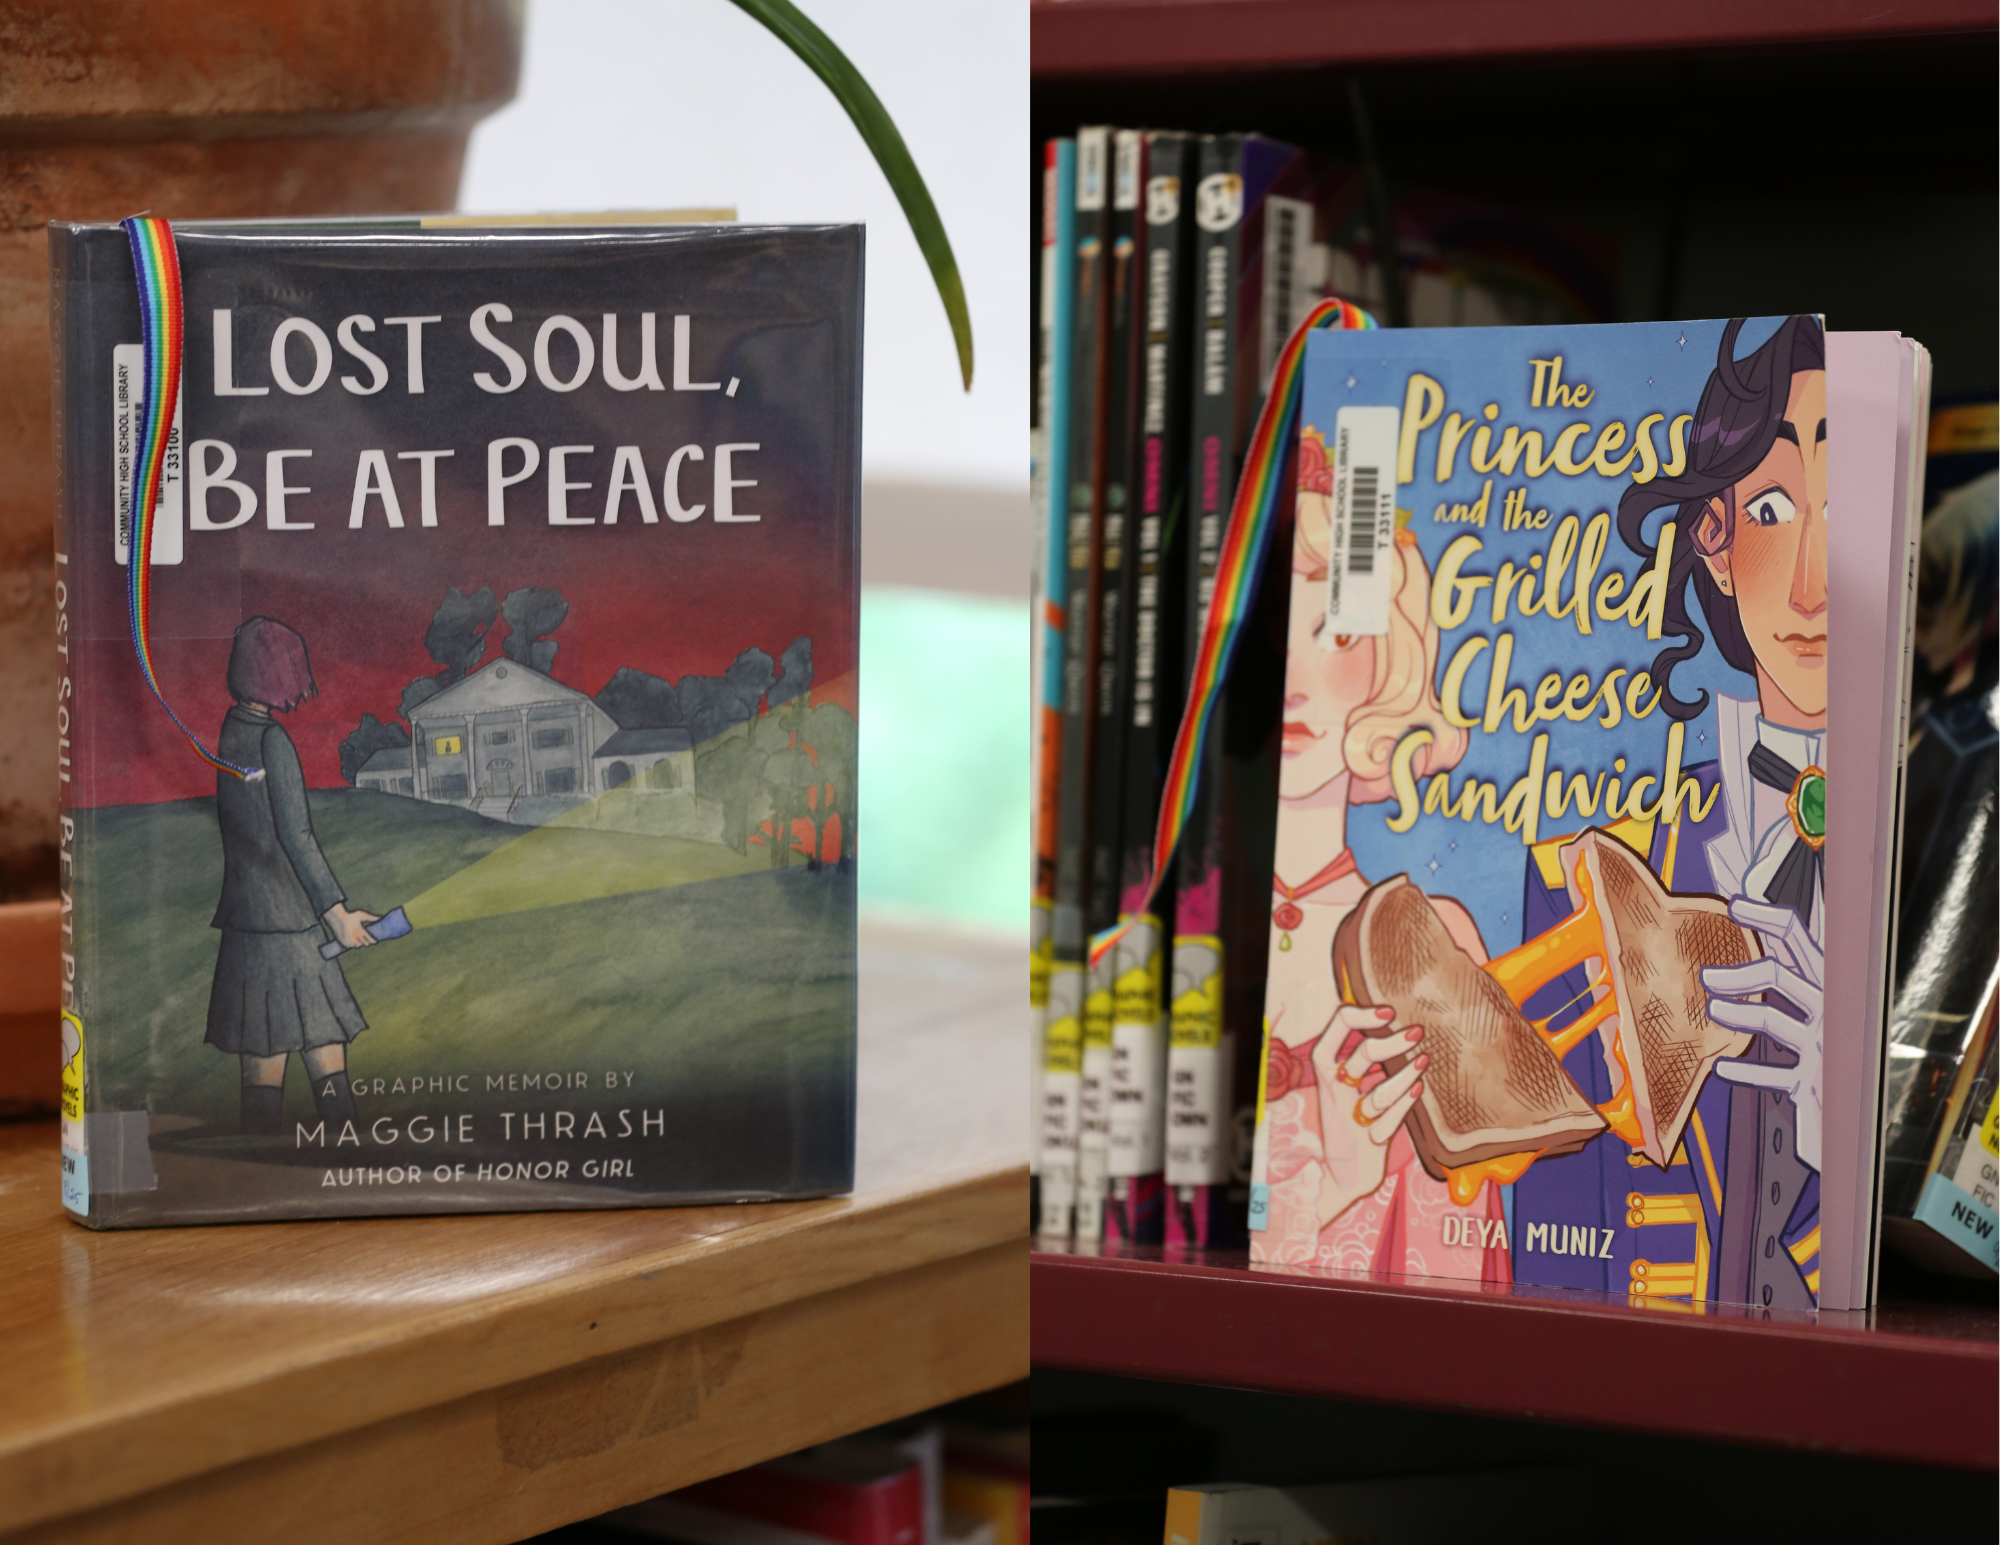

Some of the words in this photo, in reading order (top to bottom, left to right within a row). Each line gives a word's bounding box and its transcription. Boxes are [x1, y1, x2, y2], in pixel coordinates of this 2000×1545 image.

[212, 308, 442, 396] LOST
[469, 302, 741, 398] SOUL,
[118, 363, 129, 409] LIBRARY
[1528, 355, 1595, 408] The
[119, 410, 129, 454] SCHOOL
[1339, 426, 1349, 473] LIBRARY
[1397, 373, 1695, 485] Princess
[119, 456, 129, 479] HIGH
[167, 473, 179, 484] T
[188, 439, 315, 531] BE
[348, 447, 455, 529] AT
[487, 436, 761, 526] PEACE
[119, 479, 130, 547] COMMUNITY
[1336, 476, 1348, 522] SCHOOL
[1379, 493, 1392, 535] 33111
[1433, 478, 1494, 529] and
[1502, 487, 1553, 531] the
[1334, 522, 1344, 550] HIGH
[1378, 540, 1388, 550] T
[1330, 550, 1343, 615] COMMUNITY
[1430, 512, 1677, 641] Grilled
[55, 552, 69, 663] LOST
[1441, 633, 1663, 734] Cheese
[1385, 722, 1721, 846] Sandwich
[60, 814, 73, 878] BE
[61, 888, 73, 944] AT
[62, 1086, 79, 1102] APHIC
[321, 1079, 337, 1097] A
[351, 1075, 470, 1096] GRAPHIC
[485, 1071, 589, 1092] MEMOIR
[605, 1071, 635, 1089] BY
[296, 1114, 475, 1149] MAGGIE
[500, 1109, 665, 1141] THRASH
[62, 1155, 75, 1175] EW
[321, 1165, 421, 1188] AUTHOR
[433, 1163, 466, 1183] OF
[477, 1160, 570, 1181] HONOR
[582, 1158, 635, 1179] GIRL
[1442, 1215, 1508, 1250] DEYA
[1526, 1222, 1615, 1259] MUNIZ
[1951, 1200, 1994, 1240] NEW
